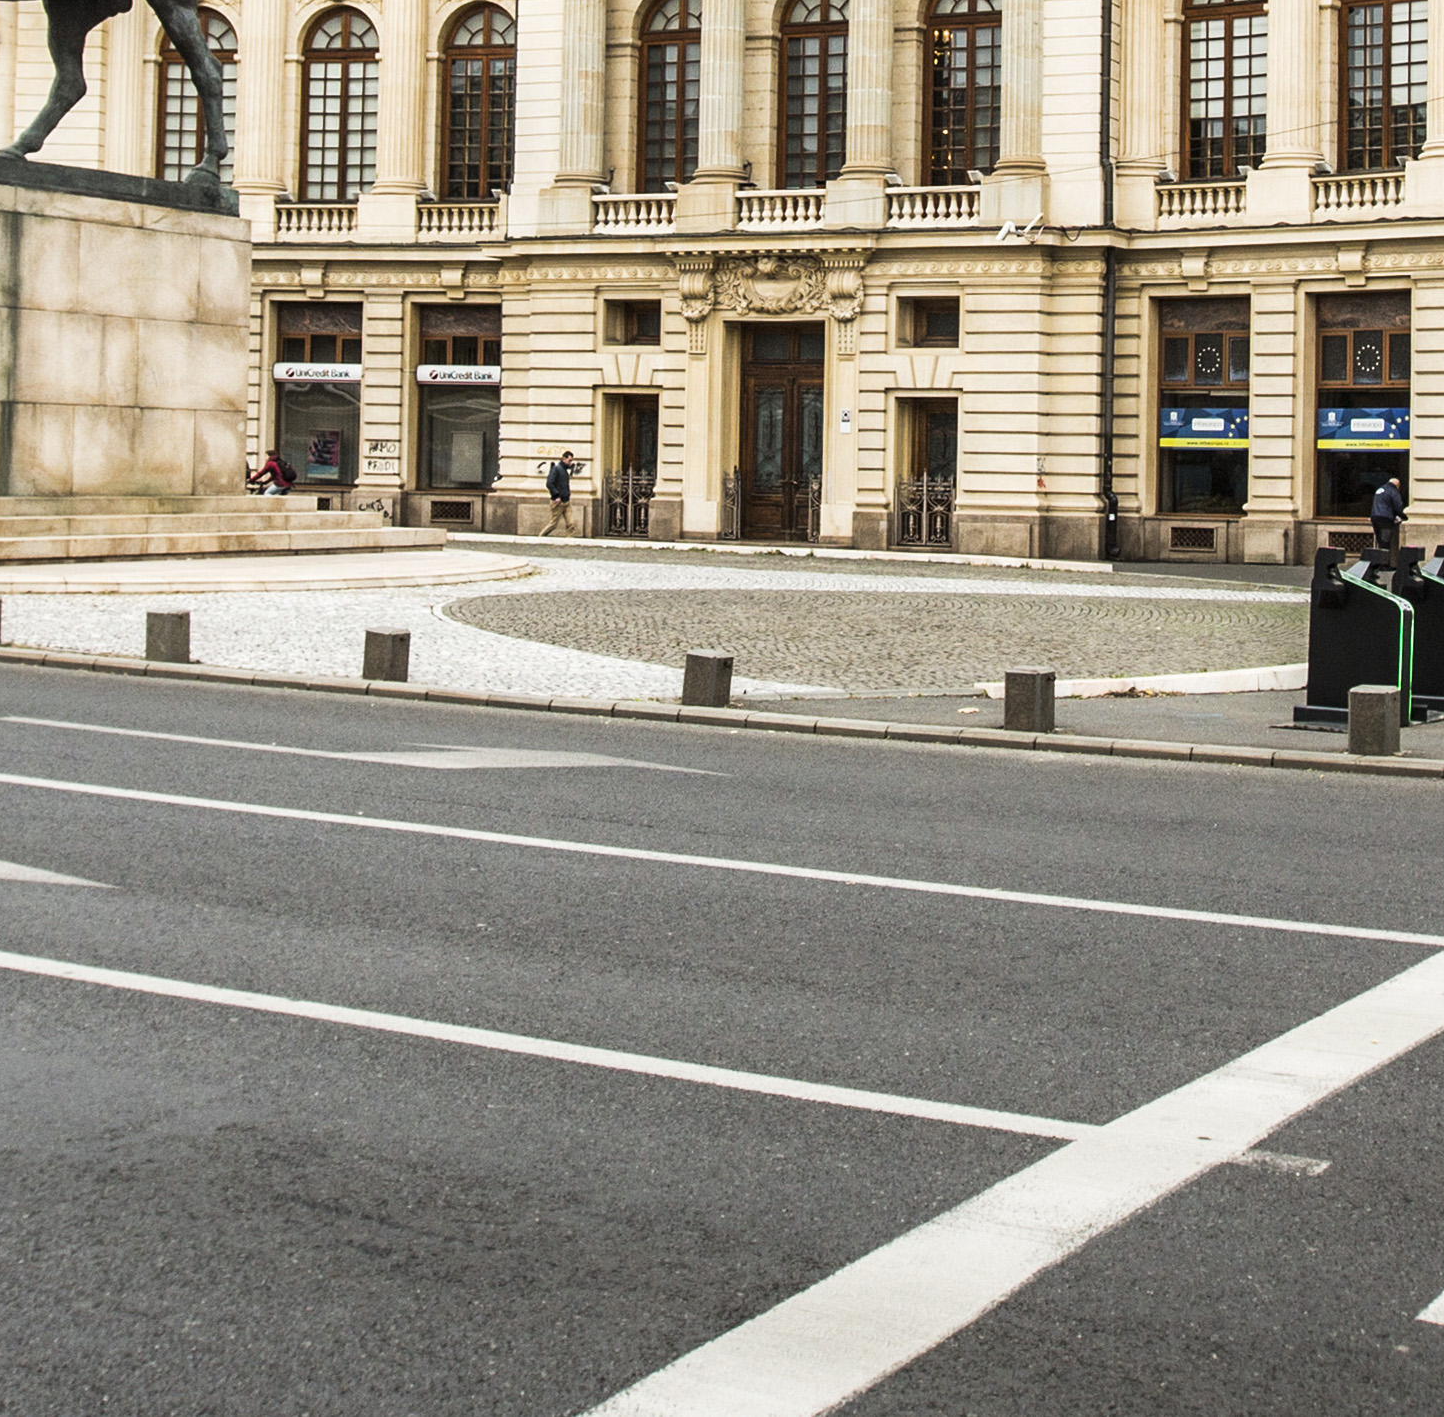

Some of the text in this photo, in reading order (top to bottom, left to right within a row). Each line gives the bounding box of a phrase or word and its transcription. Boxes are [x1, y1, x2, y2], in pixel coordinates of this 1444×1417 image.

[295, 368, 351, 379] UniCredit Bank
[439, 370, 494, 381] UniCredit Bank
